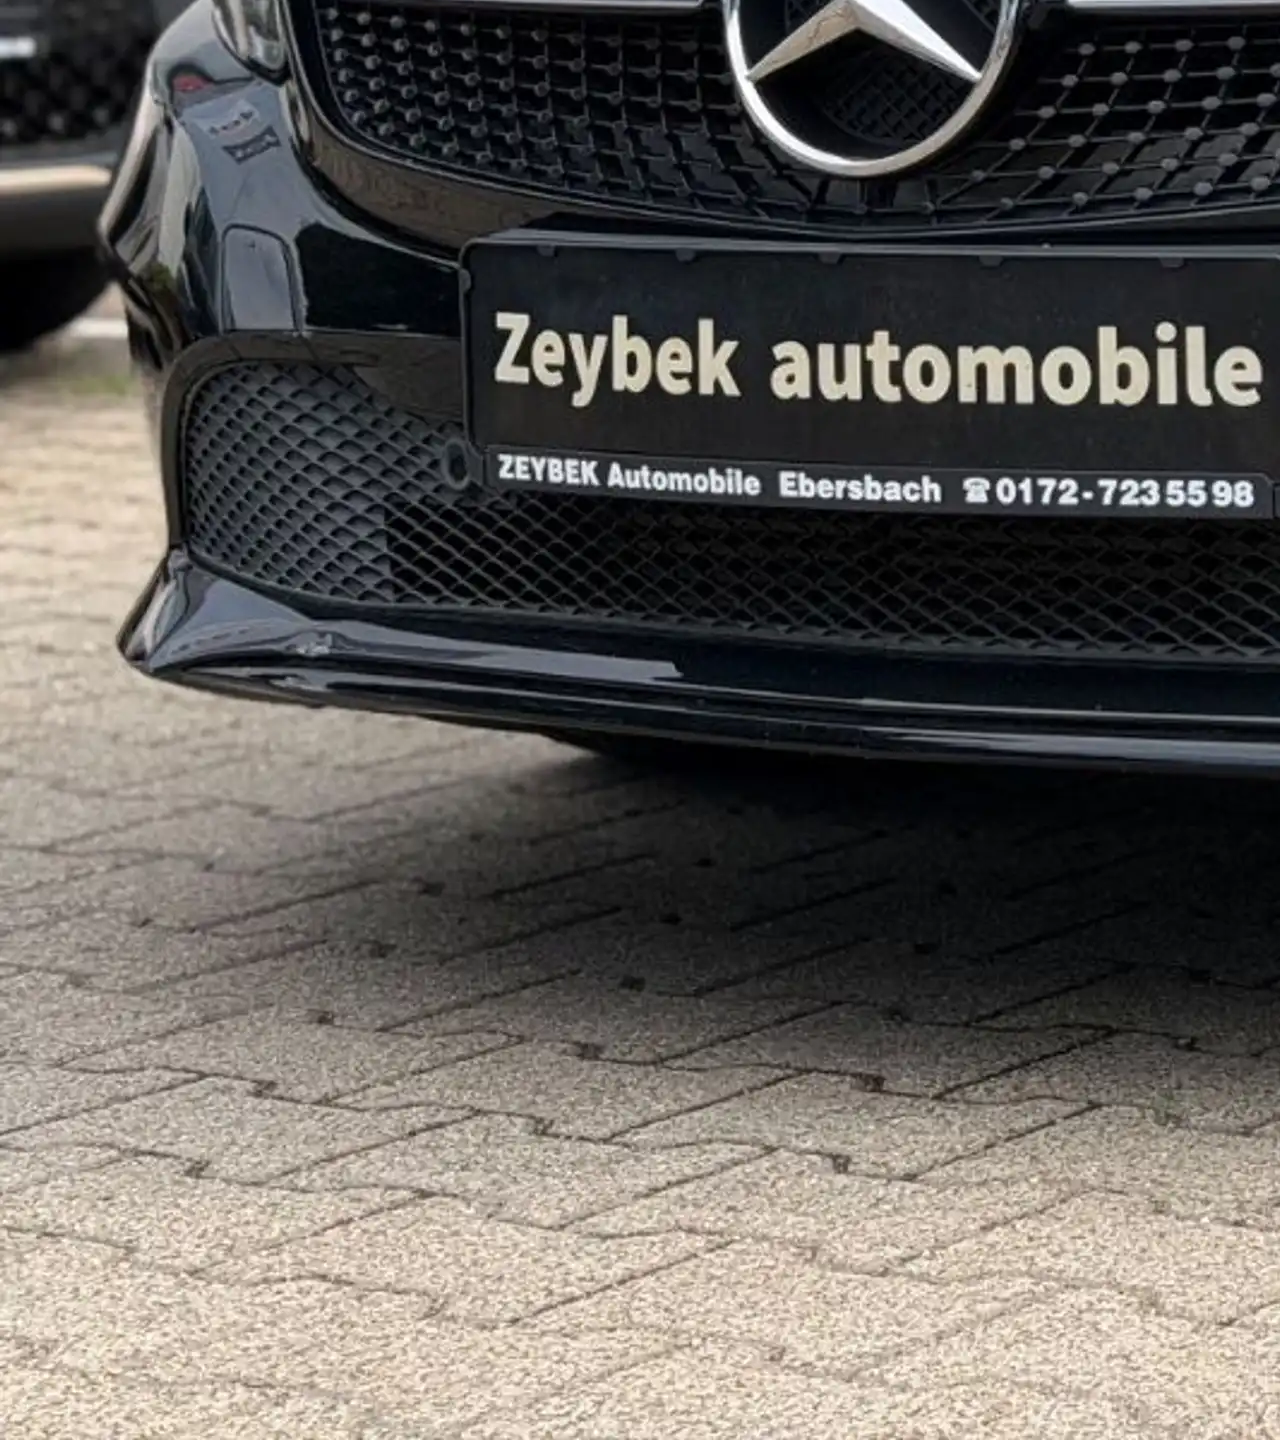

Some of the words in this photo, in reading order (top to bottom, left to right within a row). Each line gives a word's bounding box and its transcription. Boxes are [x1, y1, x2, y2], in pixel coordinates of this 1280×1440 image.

[495, 312, 741, 406] Zeybek
[770, 321, 1263, 406] automobile
[497, 453, 600, 487] ZEYBEK
[607, 461, 761, 496] Automobile
[778, 470, 942, 503] Ebersbach
